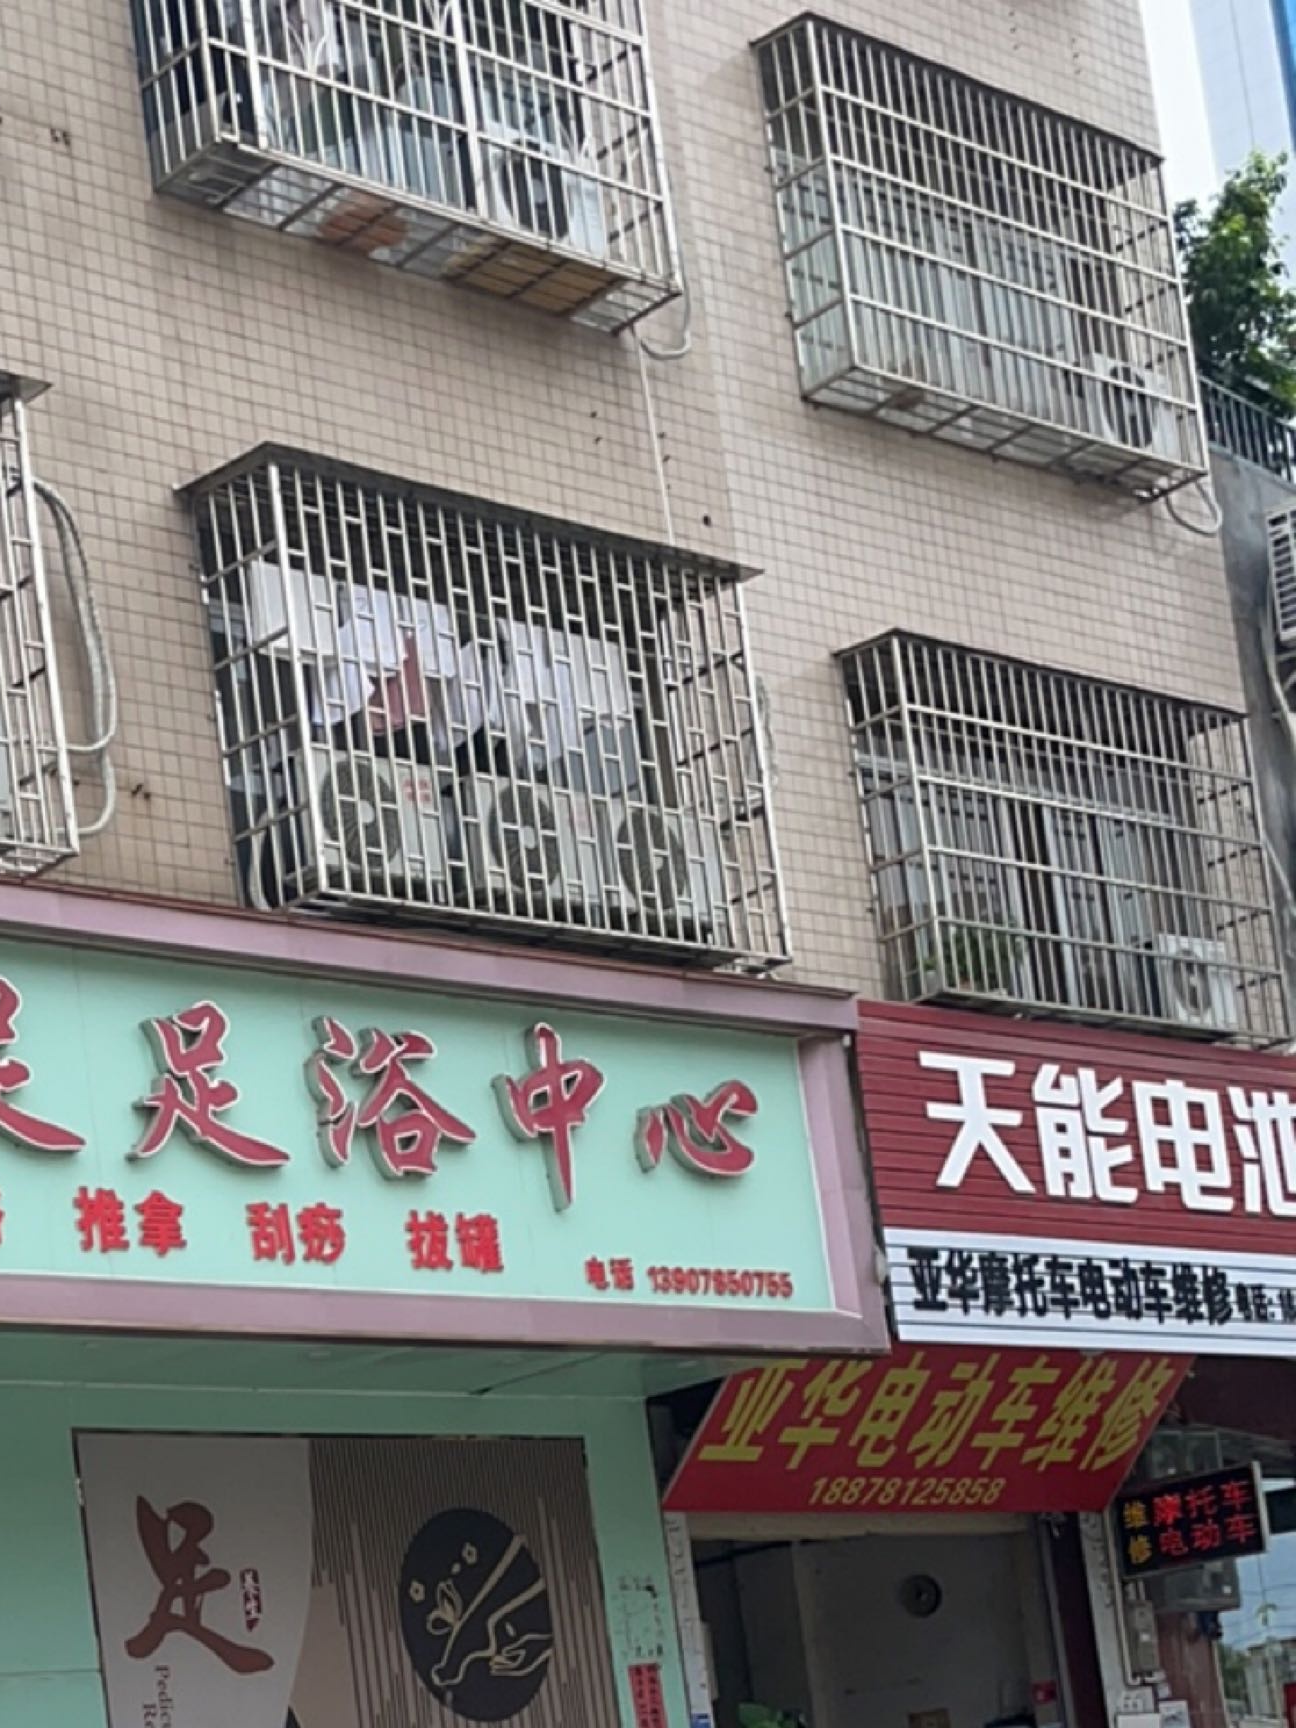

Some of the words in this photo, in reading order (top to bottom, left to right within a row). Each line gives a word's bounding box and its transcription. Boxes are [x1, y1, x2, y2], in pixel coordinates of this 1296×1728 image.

[918, 1050, 1296, 1217] 天能电池
[74, 1186, 187, 1257] 推拿
[245, 1201, 346, 1265] 刮痧
[404, 1209, 504, 1273] 拔罐
[584, 1255, 635, 1291] 电话
[699, 1351, 1178, 1471] 亚华电动车维修
[807, 1475, 1007, 1507] 18878125858
